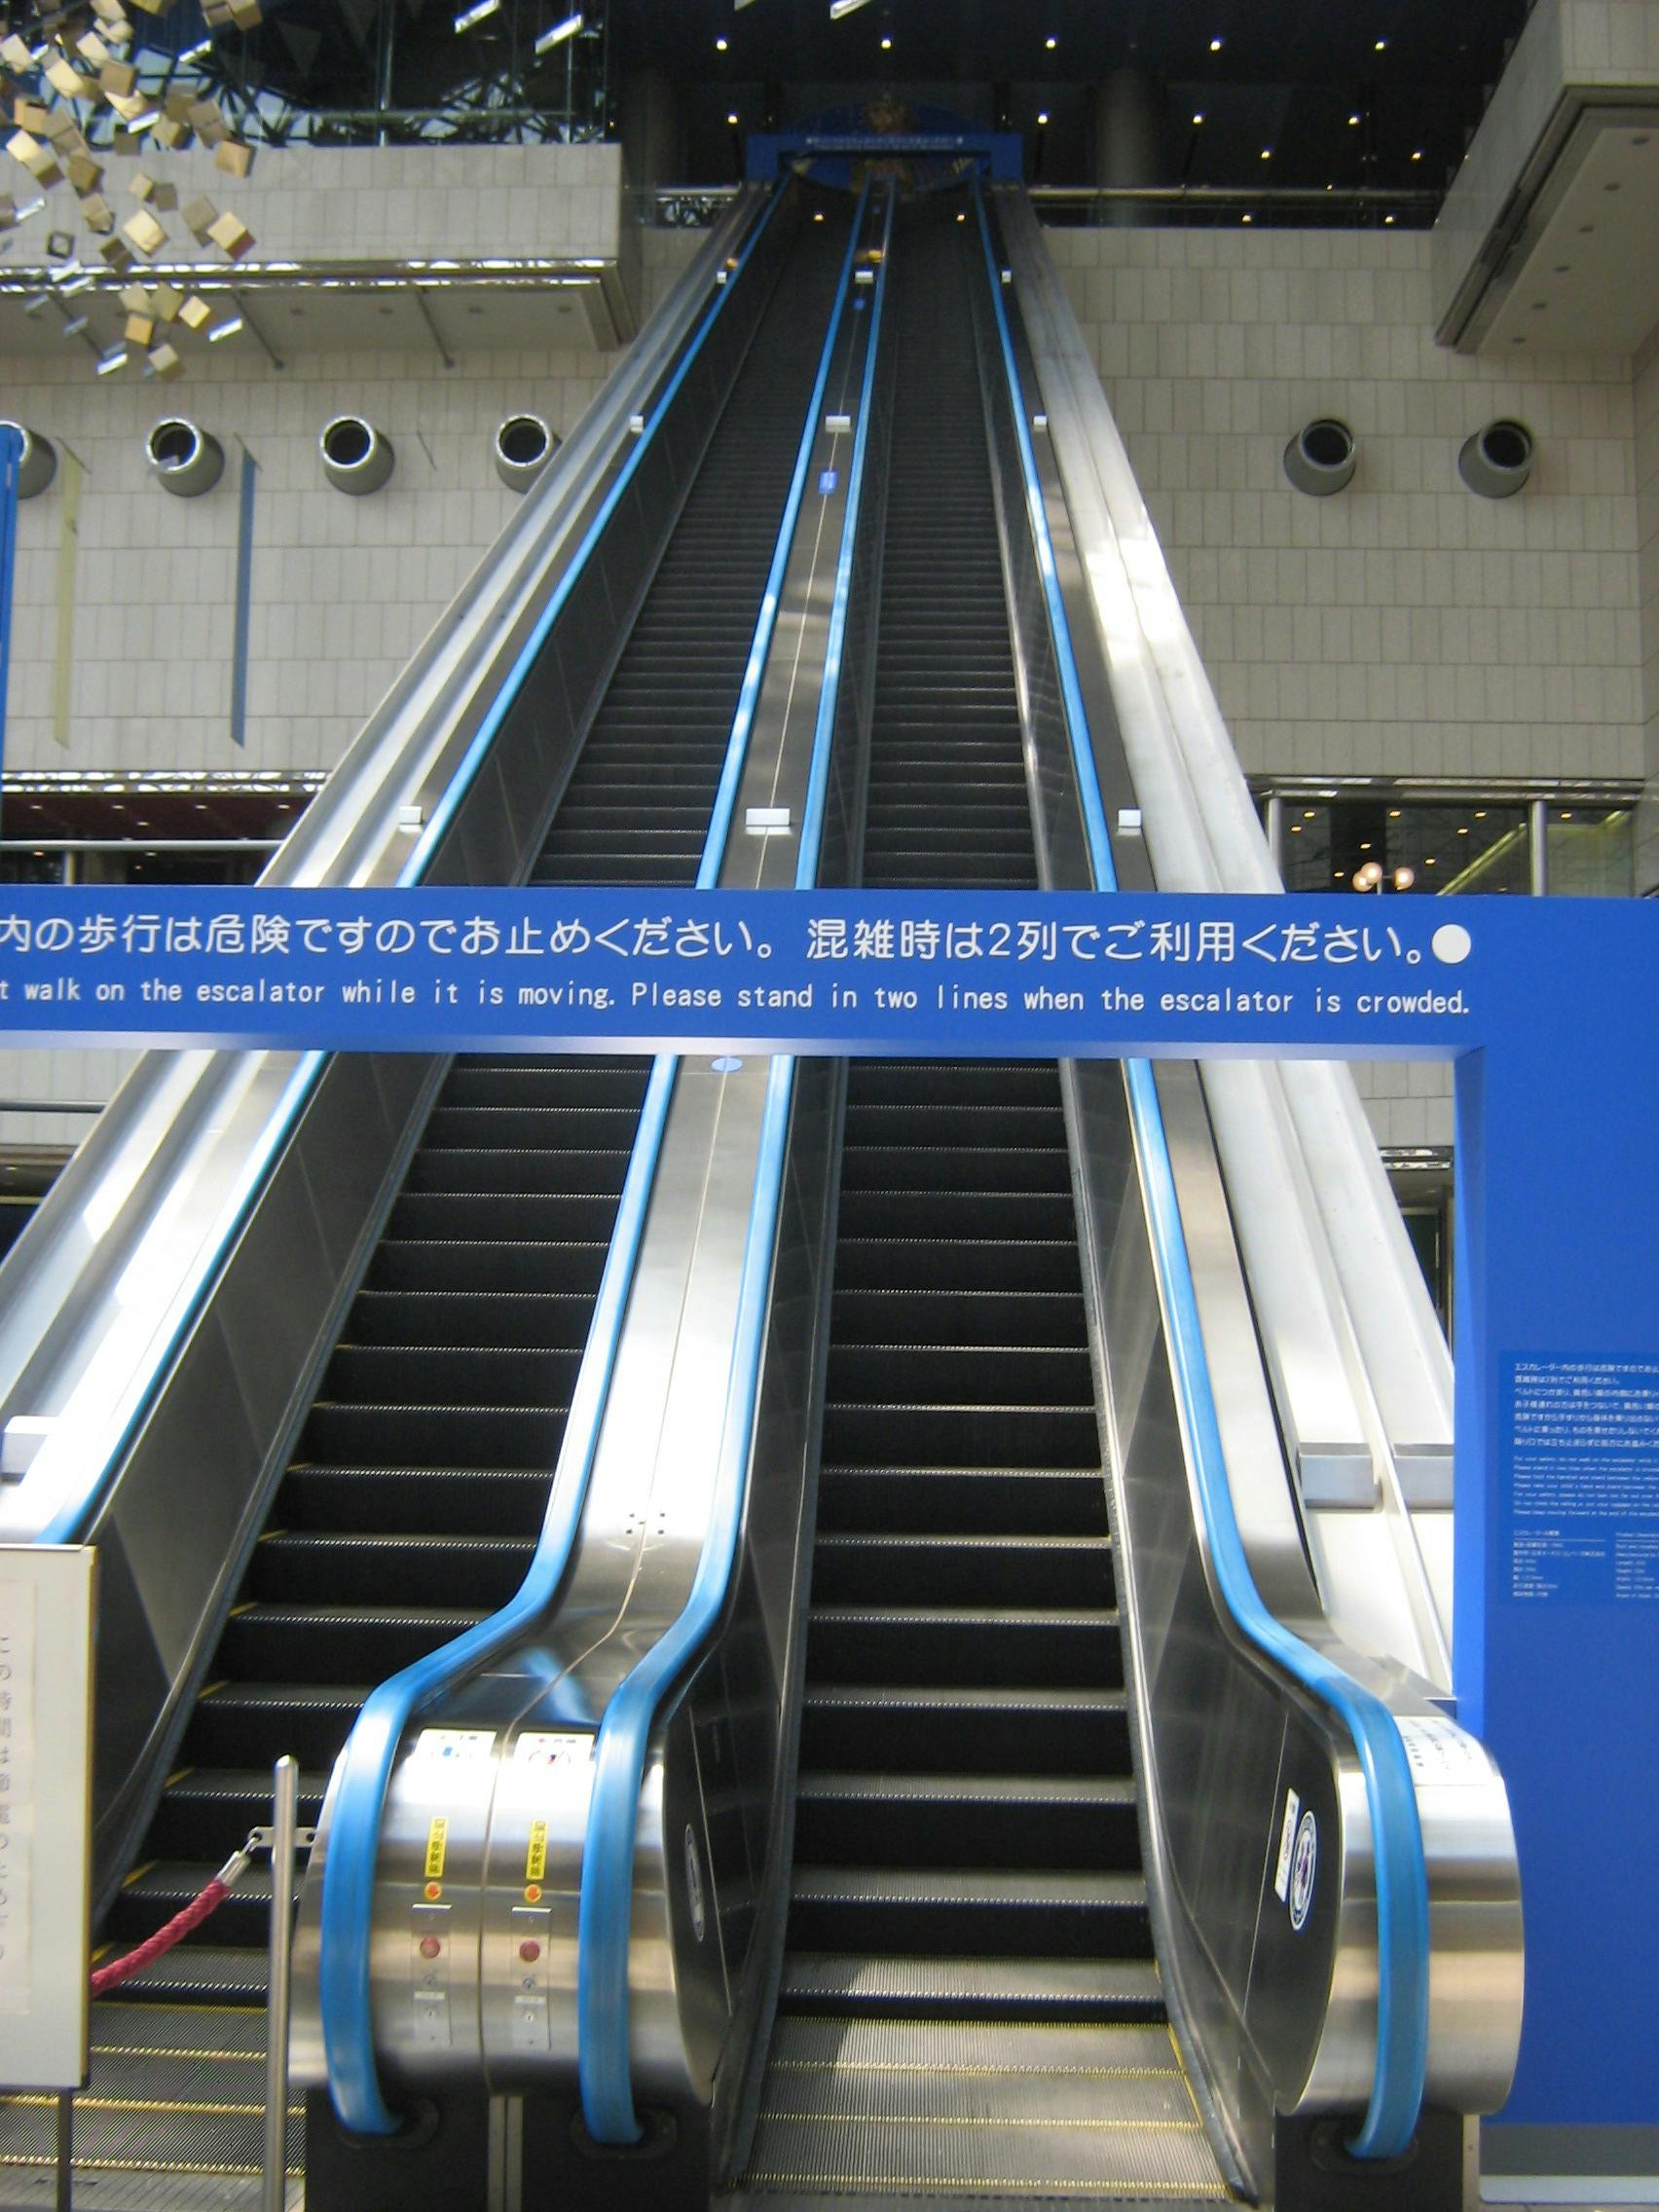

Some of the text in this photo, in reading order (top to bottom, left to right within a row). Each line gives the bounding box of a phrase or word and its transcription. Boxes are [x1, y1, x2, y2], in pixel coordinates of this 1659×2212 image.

[806, 917, 1422, 964] 混雑時は2列でご利用ください。
[25, 978, 81, 1002] walk
[95, 983, 125, 1002] on
[141, 978, 182, 1003] the
[197, 978, 324, 1004] escalator
[342, 979, 416, 1004] while
[433, 981, 459, 1005] it
[477, 982, 504, 1006] is
[517, 983, 616, 1010] moving.
[631, 981, 722, 1007] Please
[737, 983, 813, 1009] stand
[830, 984, 858, 1009] in
[874, 986, 918, 1010] two
[937, 984, 1008, 1011] lines
[1023, 985, 1084, 1012] when
[1101, 986, 1145, 1012] the
[1160, 986, 1294, 1014] escalator
[1315, 987, 1342, 1014] is
[1356, 988, 1470, 1015] crowded.
